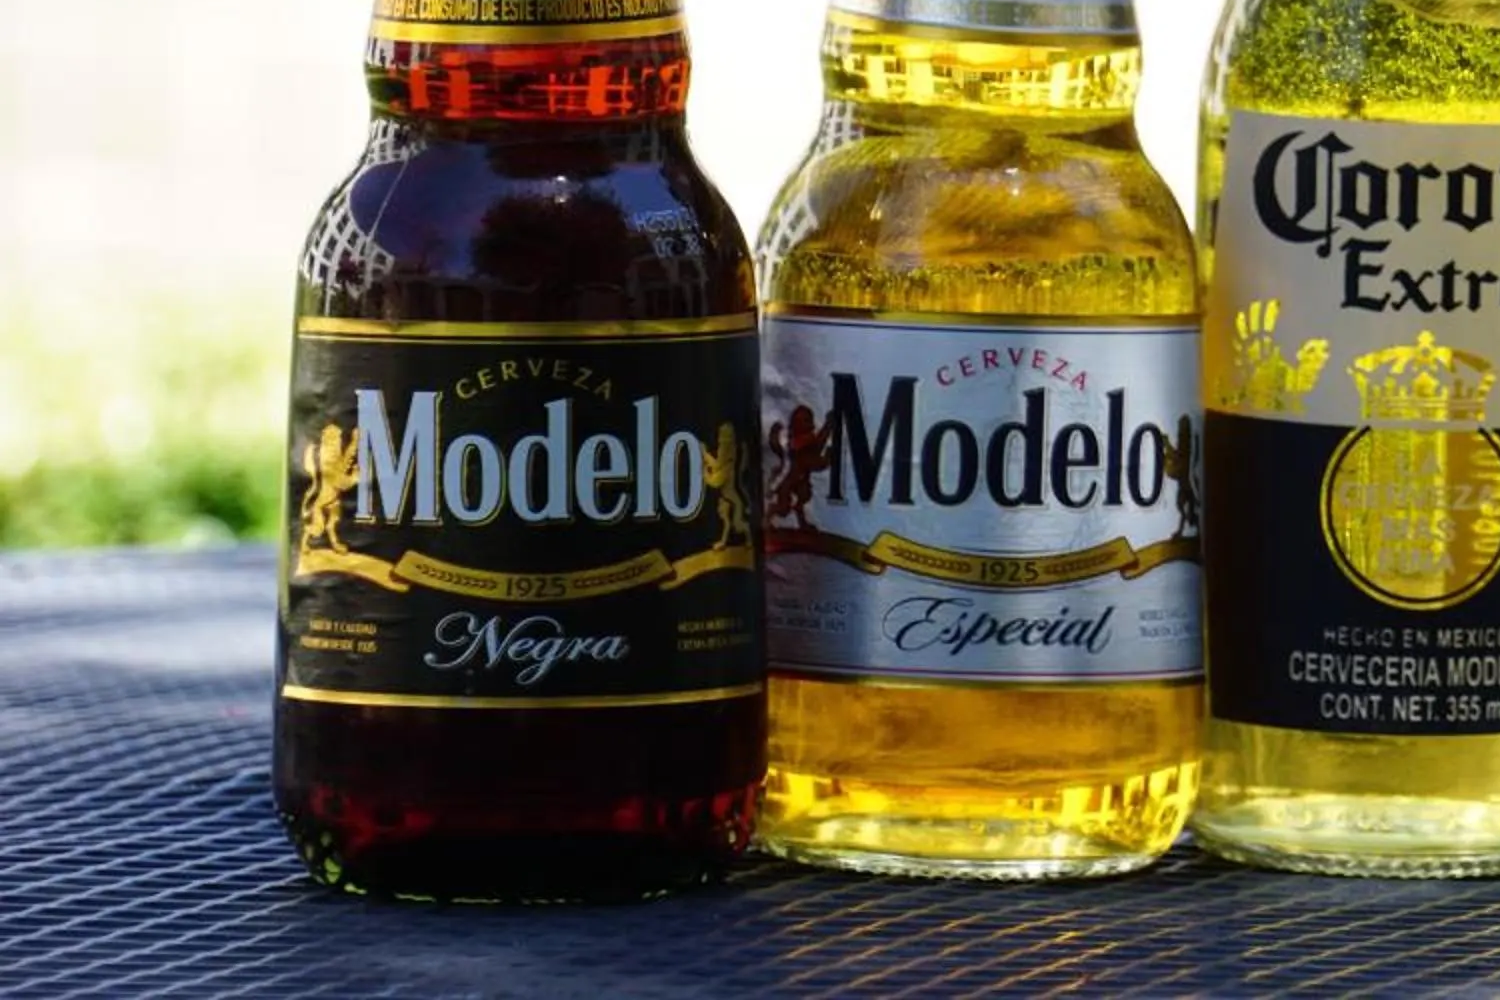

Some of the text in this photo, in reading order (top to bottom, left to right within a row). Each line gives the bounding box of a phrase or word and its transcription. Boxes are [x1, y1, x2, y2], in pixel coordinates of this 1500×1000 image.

[455, 357, 614, 400] CERVEZA
[936, 347, 1089, 391] CERVEZA
[355, 388, 706, 527] Modelo
[826, 372, 1164, 509] Modelo
[505, 576, 568, 599] 1925
[978, 560, 1040, 583] 1925
[423, 610, 629, 686] Negra
[881, 597, 1116, 656] Especial
[1323, 626, 1394, 648] HECHO
[1402, 628, 1429, 649] EN
[1288, 651, 1442, 687] CERVECERIA
[1320, 693, 1386, 721] CONT.
[1392, 695, 1441, 722] NET.
[1446, 696, 1482, 721] 355
